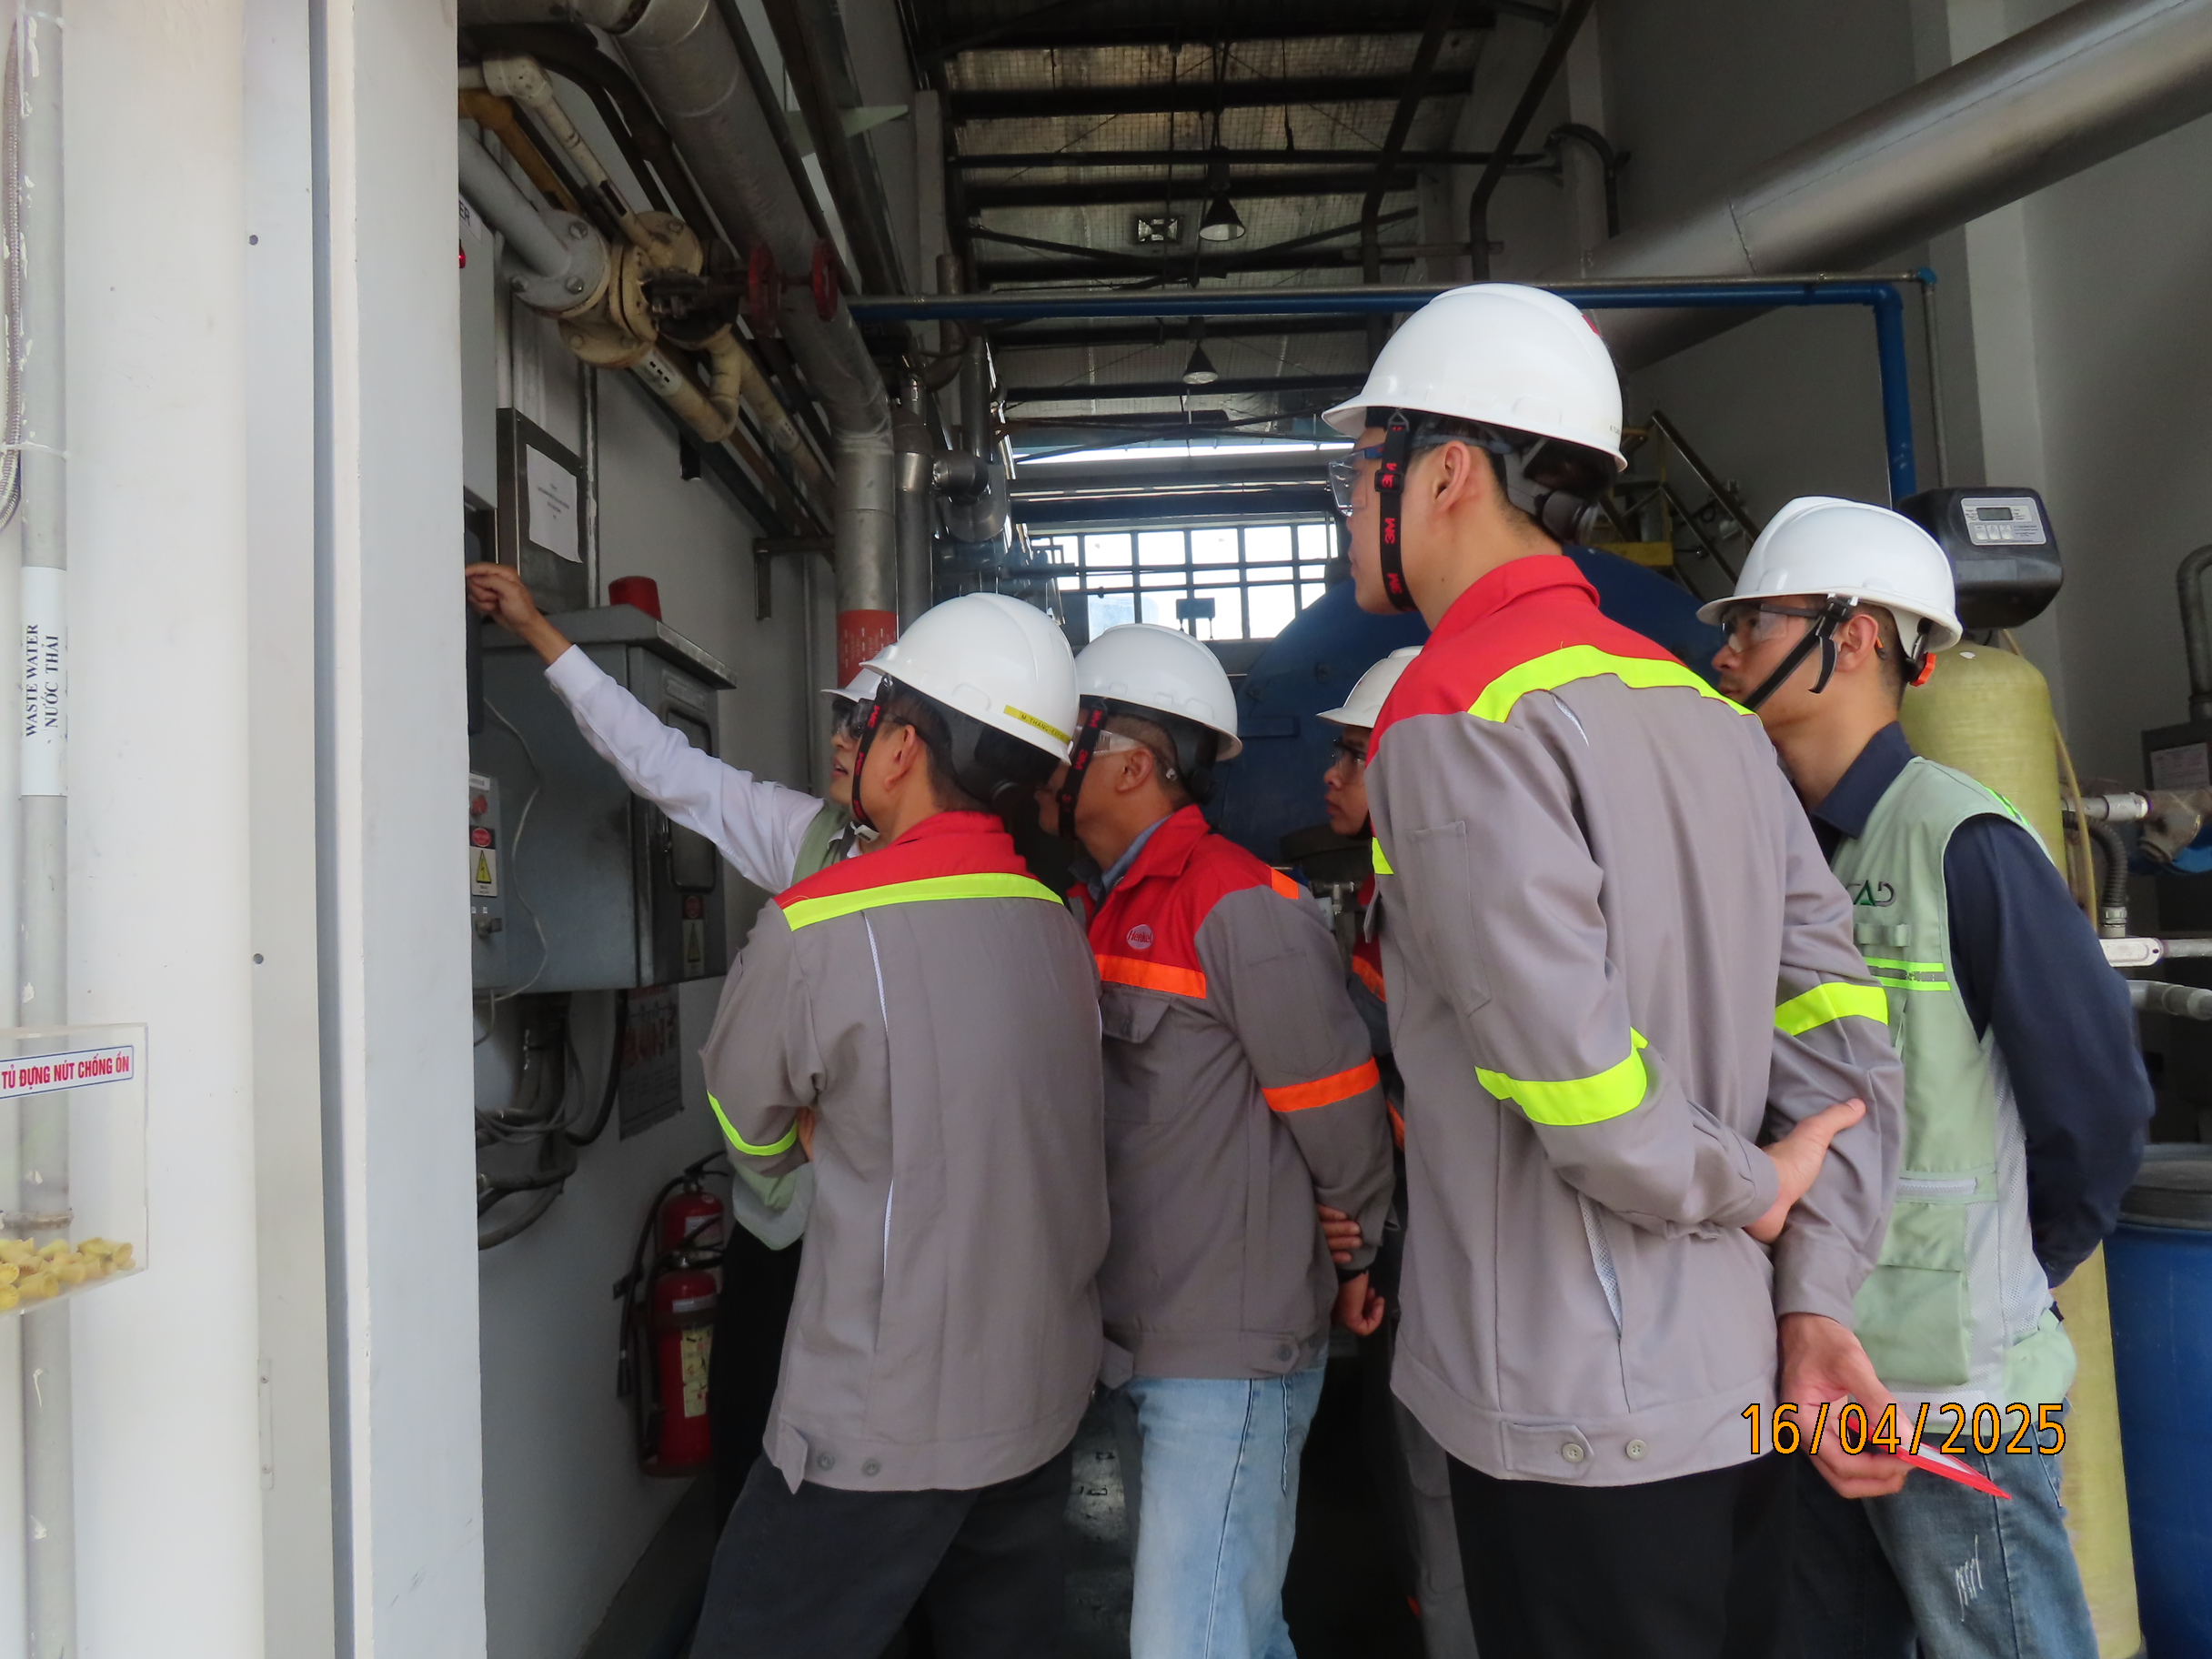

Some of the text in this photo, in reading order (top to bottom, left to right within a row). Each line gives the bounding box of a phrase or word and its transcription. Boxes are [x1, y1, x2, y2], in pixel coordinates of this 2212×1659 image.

[459, 200, 471, 226] ER
[1383, 518, 1395, 544] 3M
[1387, 573, 1403, 595] 3M
[25, 624, 38, 737] WASTE WATER
[41, 636, 59, 728] NƯỚC THẢI
[1128, 930, 1152, 943] Henkel
[1, 1064, 15, 1089] TỦ
[19, 1066, 50, 1090] ĐỰNG
[54, 1060, 75, 1082] NÚT
[77, 1053, 113, 1078] CHỐNG
